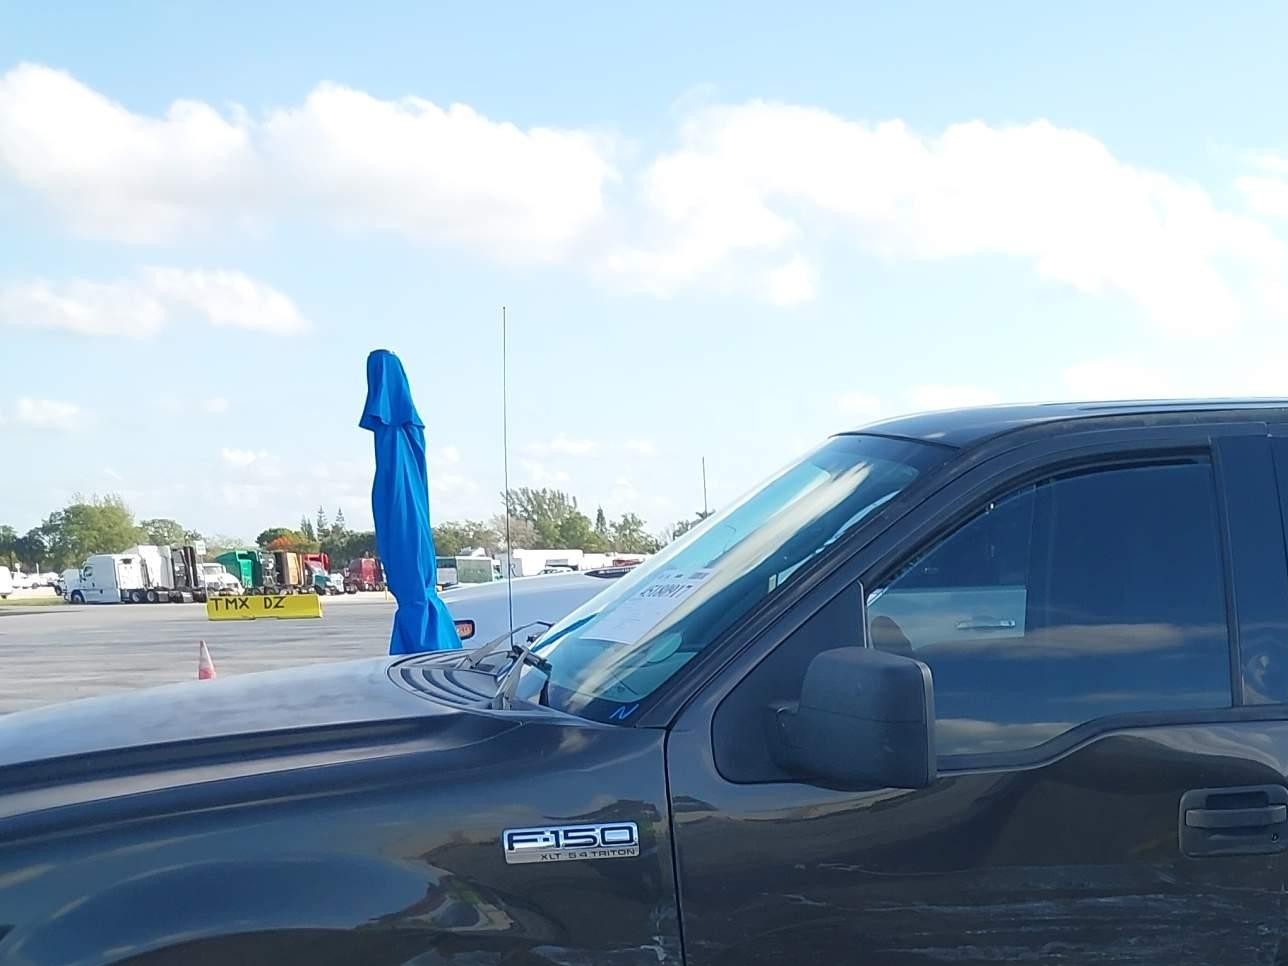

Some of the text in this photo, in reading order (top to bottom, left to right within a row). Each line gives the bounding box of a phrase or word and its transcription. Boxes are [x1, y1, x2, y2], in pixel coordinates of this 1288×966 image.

[210, 596, 286, 611] TMX DZ
[540, 852, 563, 861] XLT
[590, 849, 635, 858] TRITON
